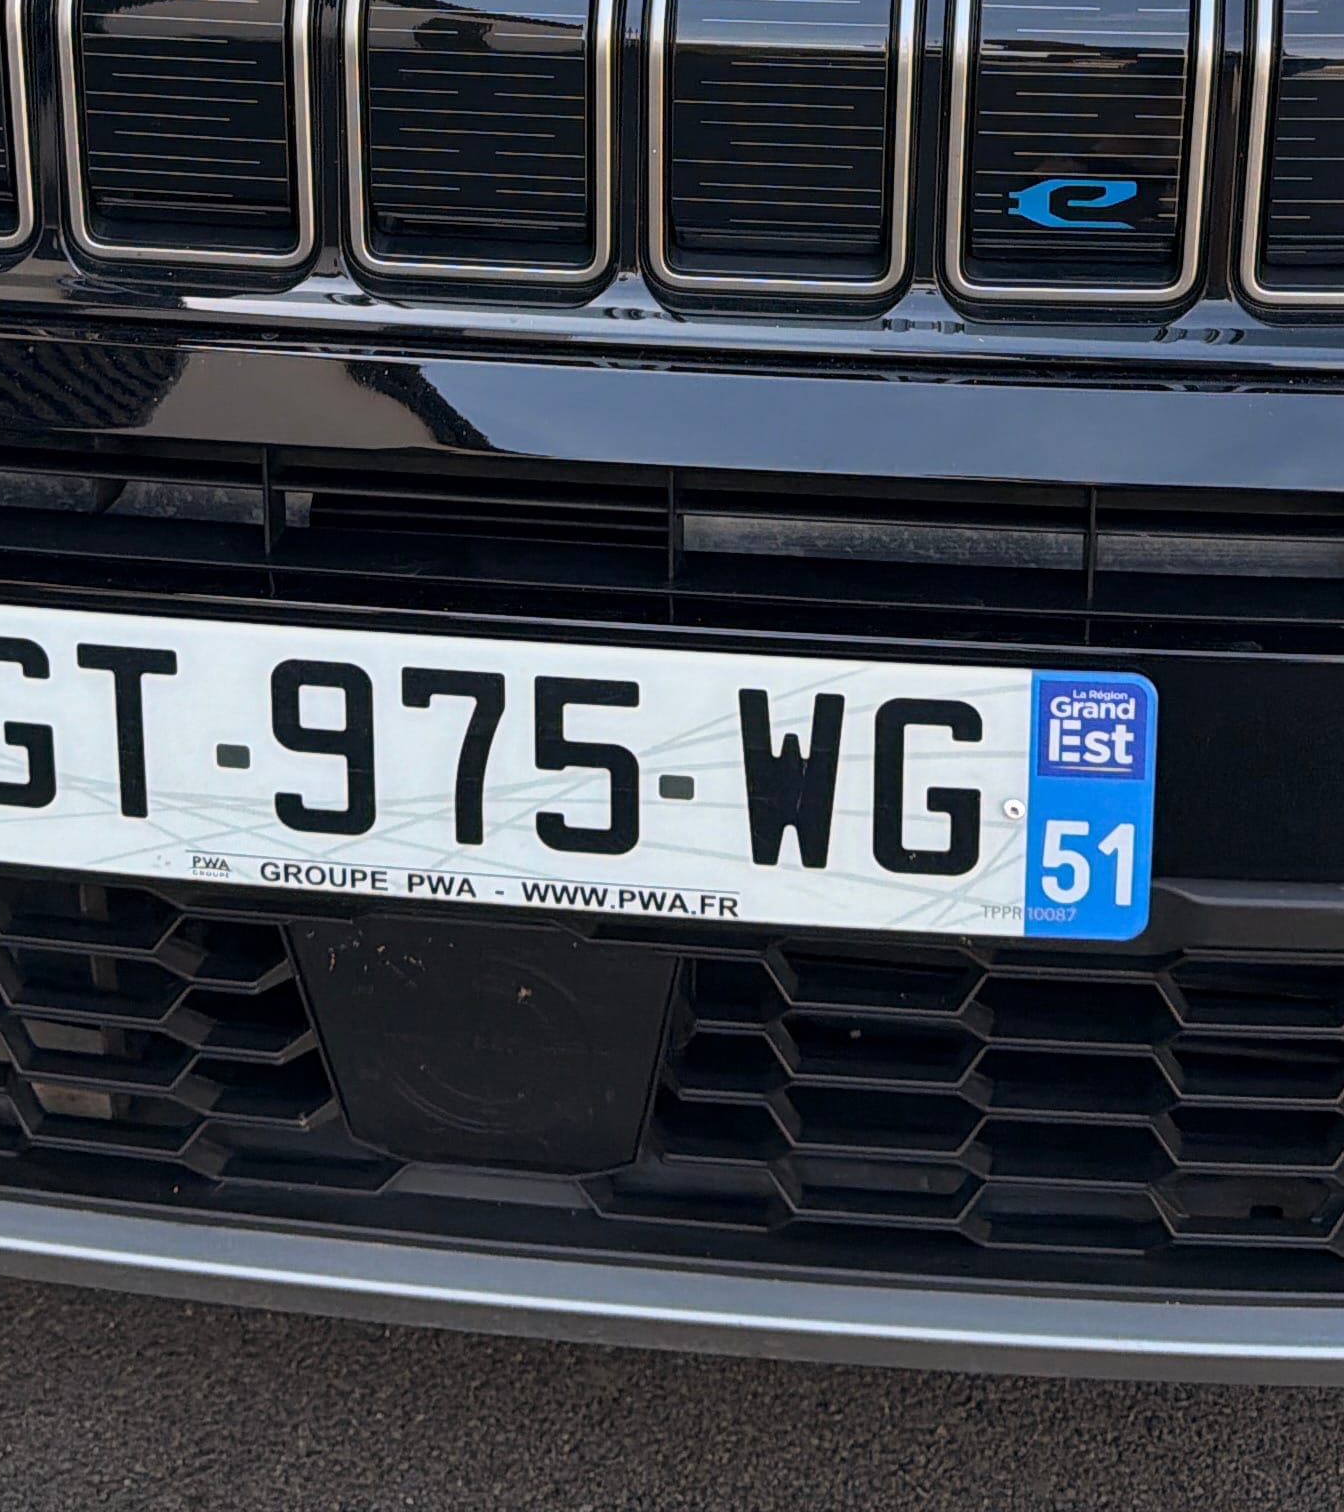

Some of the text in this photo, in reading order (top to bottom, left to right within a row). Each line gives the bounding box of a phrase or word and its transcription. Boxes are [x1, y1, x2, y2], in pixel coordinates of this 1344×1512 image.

[1050, 695, 1136, 720] Grand
[1072, 689, 1128, 701] La Région
[1048, 718, 1135, 765] Est
[192, 855, 231, 872] PWA
[192, 869, 230, 878] GROUPE
[1041, 820, 1137, 907] 51
[260, 861, 388, 891] GROUPE
[407, 873, 477, 898] PWA
[521, 881, 739, 918] WWW.PWA.FR
